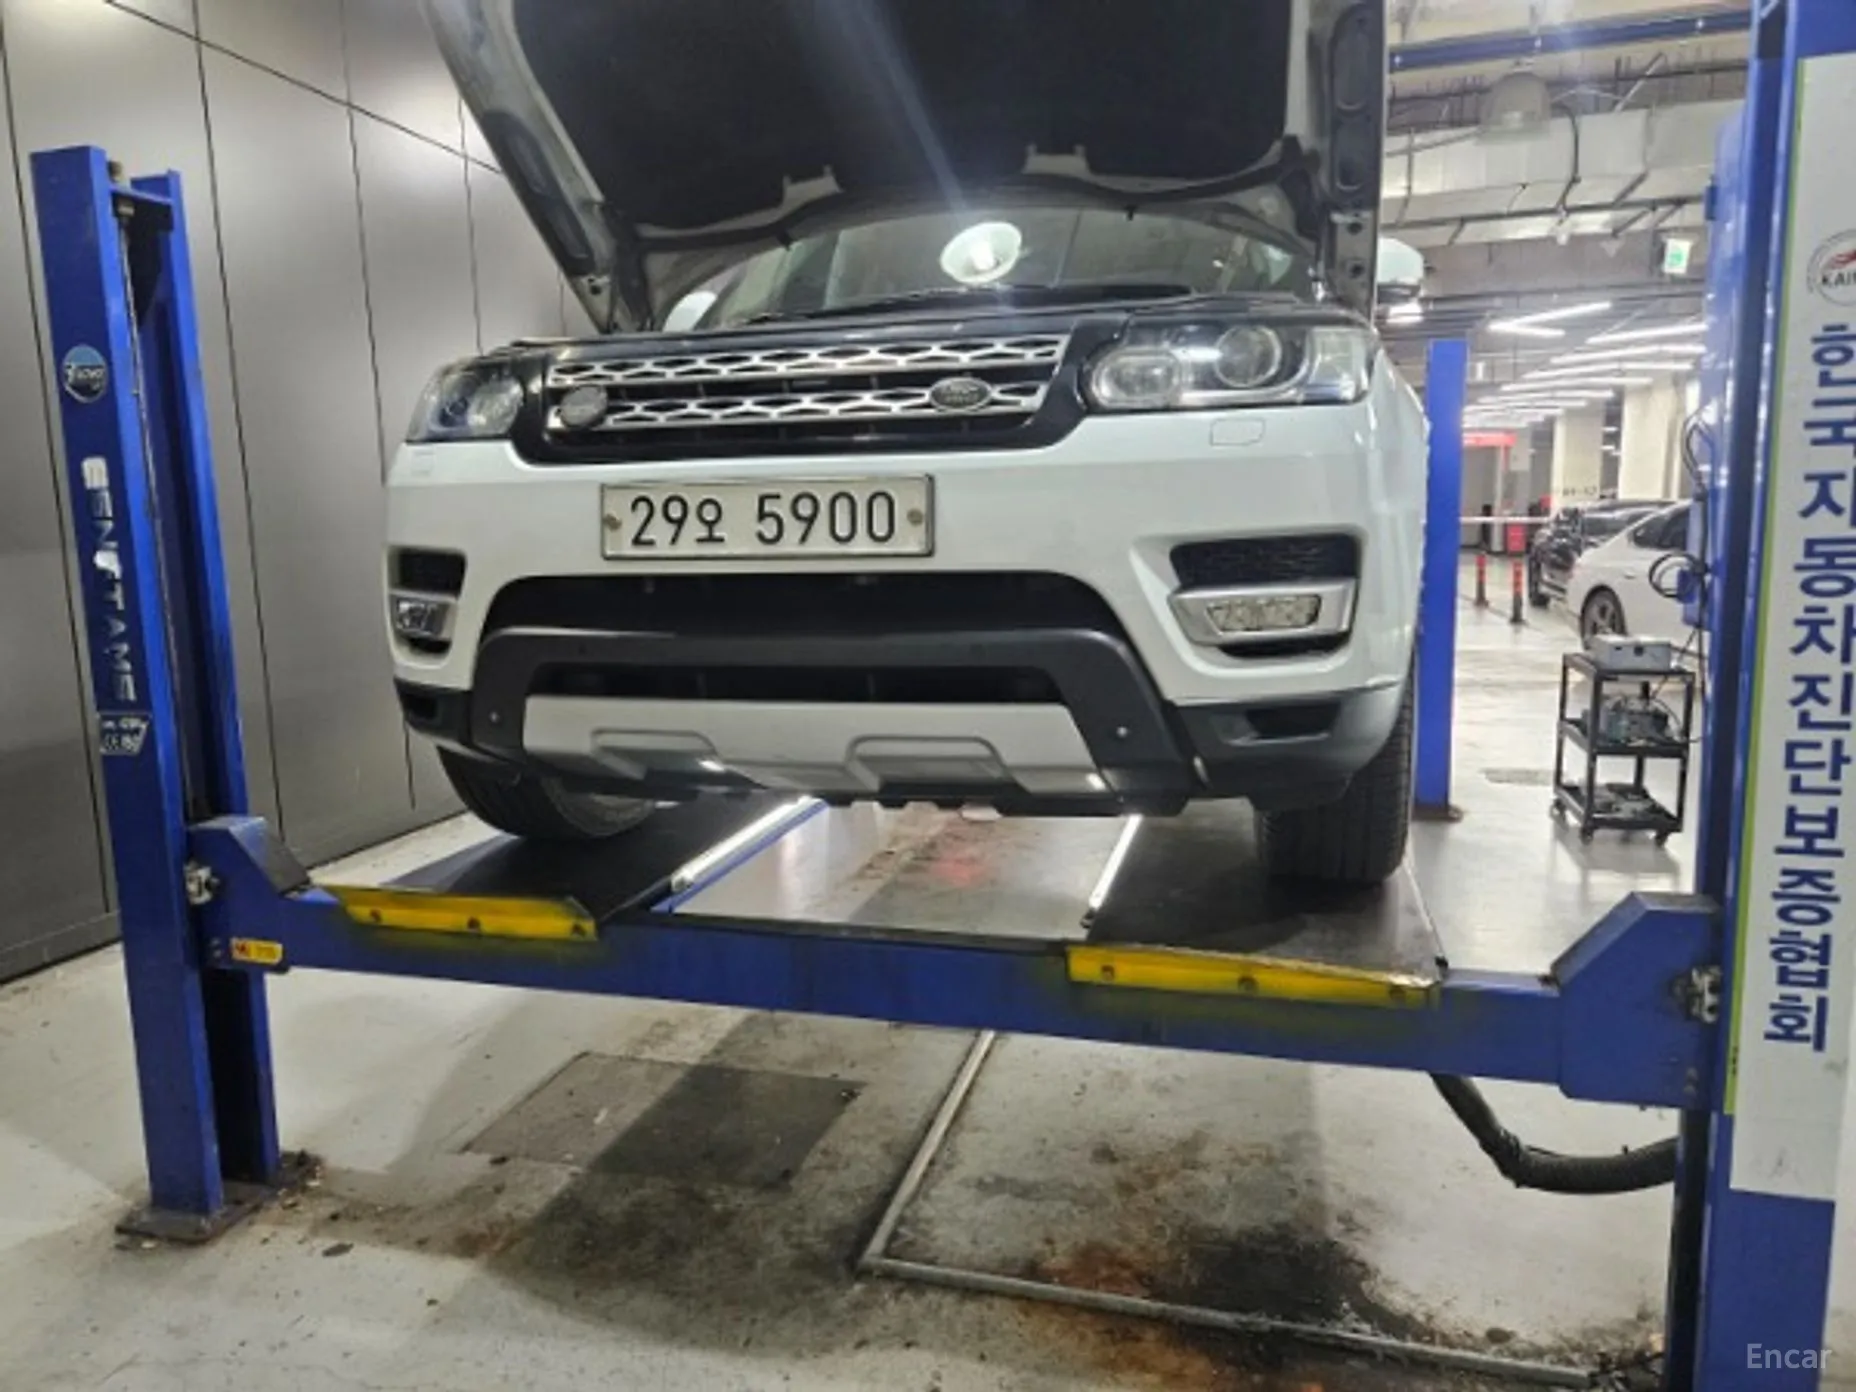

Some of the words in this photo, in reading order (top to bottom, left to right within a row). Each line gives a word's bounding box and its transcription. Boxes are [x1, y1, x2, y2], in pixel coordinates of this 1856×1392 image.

[1821, 271, 1856, 288] KAI
[630, 494, 726, 546] 29오
[755, 491, 895, 546] 5900
